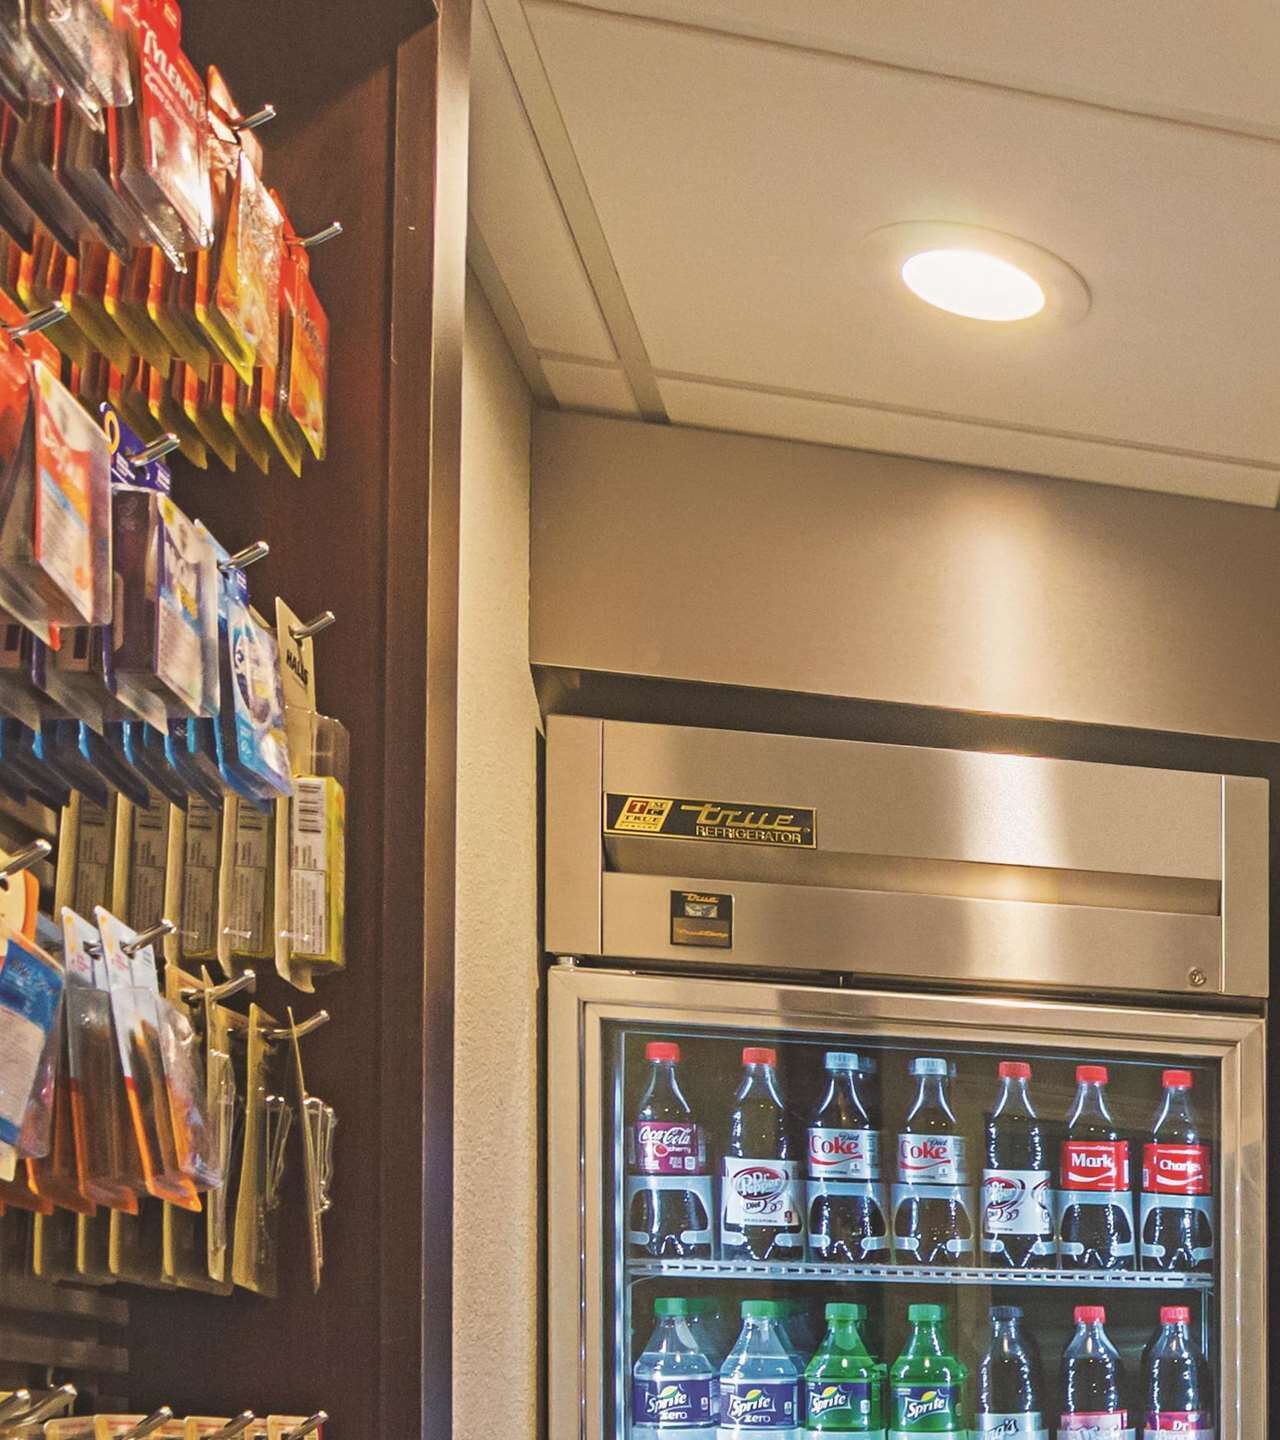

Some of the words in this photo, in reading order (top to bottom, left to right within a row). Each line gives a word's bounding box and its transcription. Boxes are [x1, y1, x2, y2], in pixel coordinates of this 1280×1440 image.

[696, 825, 801, 844] REFRIGERATOR
[638, 1125, 691, 1144] Coca-Cola
[809, 1135, 859, 1154] Coke
[901, 1140, 948, 1160] Coke
[1071, 1153, 1113, 1168] Mark
[646, 1393, 688, 1413] Sprite
[731, 1396, 770, 1416] Sprite
[810, 1393, 846, 1414] Sprite
[905, 1396, 946, 1418] Sprite
[744, 1413, 771, 1423] zero
